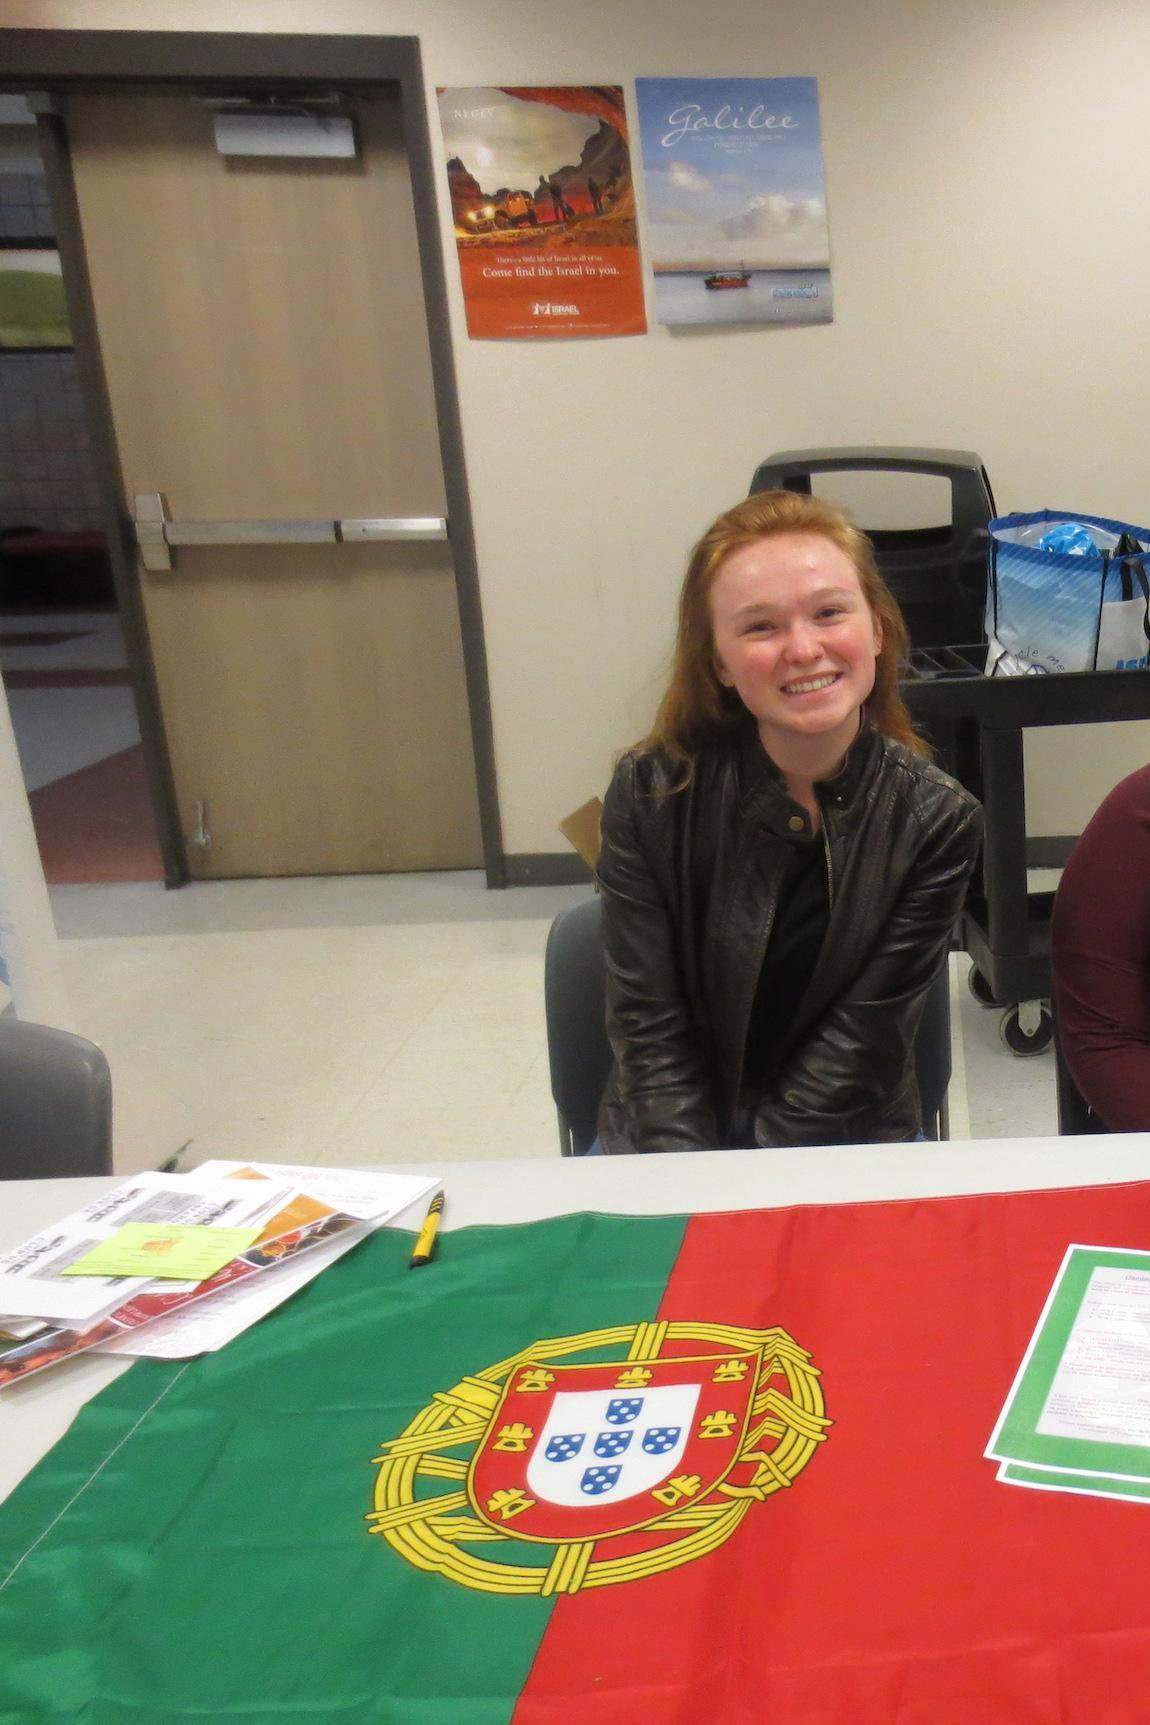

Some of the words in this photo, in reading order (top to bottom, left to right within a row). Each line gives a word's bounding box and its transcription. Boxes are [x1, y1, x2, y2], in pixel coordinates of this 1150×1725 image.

[661, 104, 799, 147] Galilee
[483, 268, 512, 278] Come
[515, 267, 535, 277] find
[538, 266, 553, 276] the
[556, 265, 583, 276] Israel
[586, 266, 595, 275] in
[599, 267, 620, 277] you.
[551, 305, 579, 314] ISRAEL
